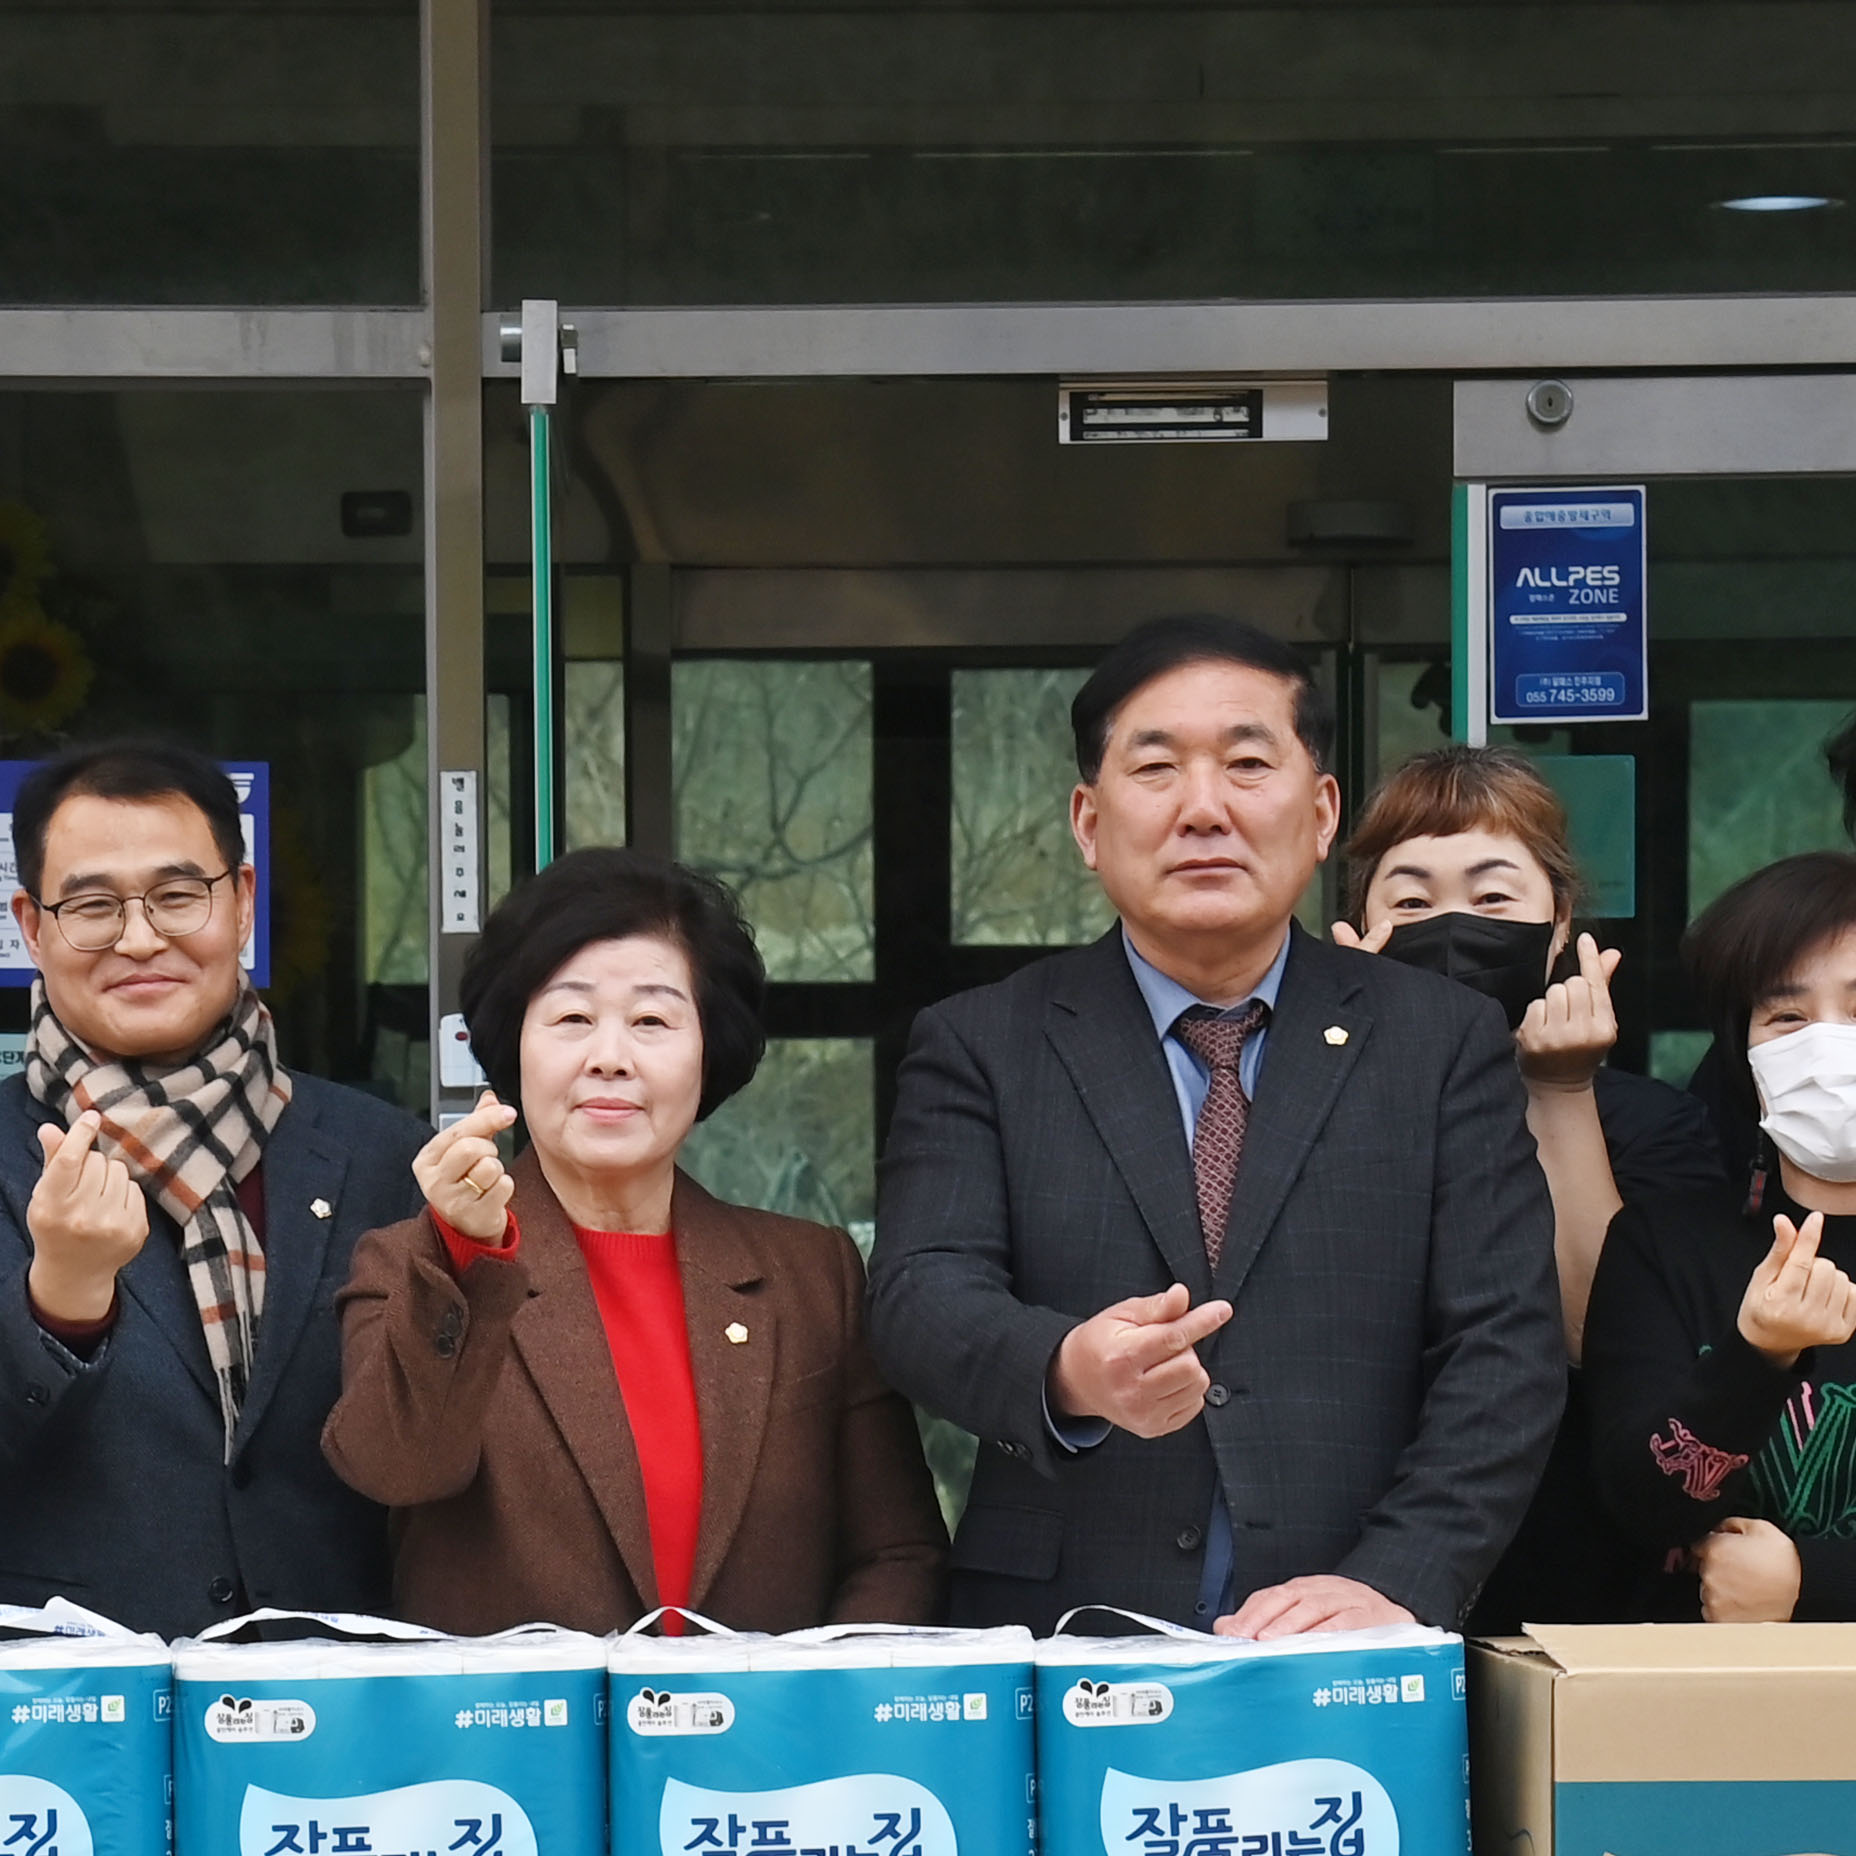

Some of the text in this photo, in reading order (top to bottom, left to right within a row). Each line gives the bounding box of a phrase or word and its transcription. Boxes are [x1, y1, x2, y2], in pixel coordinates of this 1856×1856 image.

[1516, 566, 1620, 587] ALLPES
[1569, 588, 1619, 605] ZONE
[1549, 688, 1615, 702] 745-3599
[1312, 1684, 1399, 1705] #미래생활
[11, 1702, 98, 1723] #미래생활
[454, 1707, 541, 1728] #미래생활
[874, 1701, 961, 1722] #미래생활
